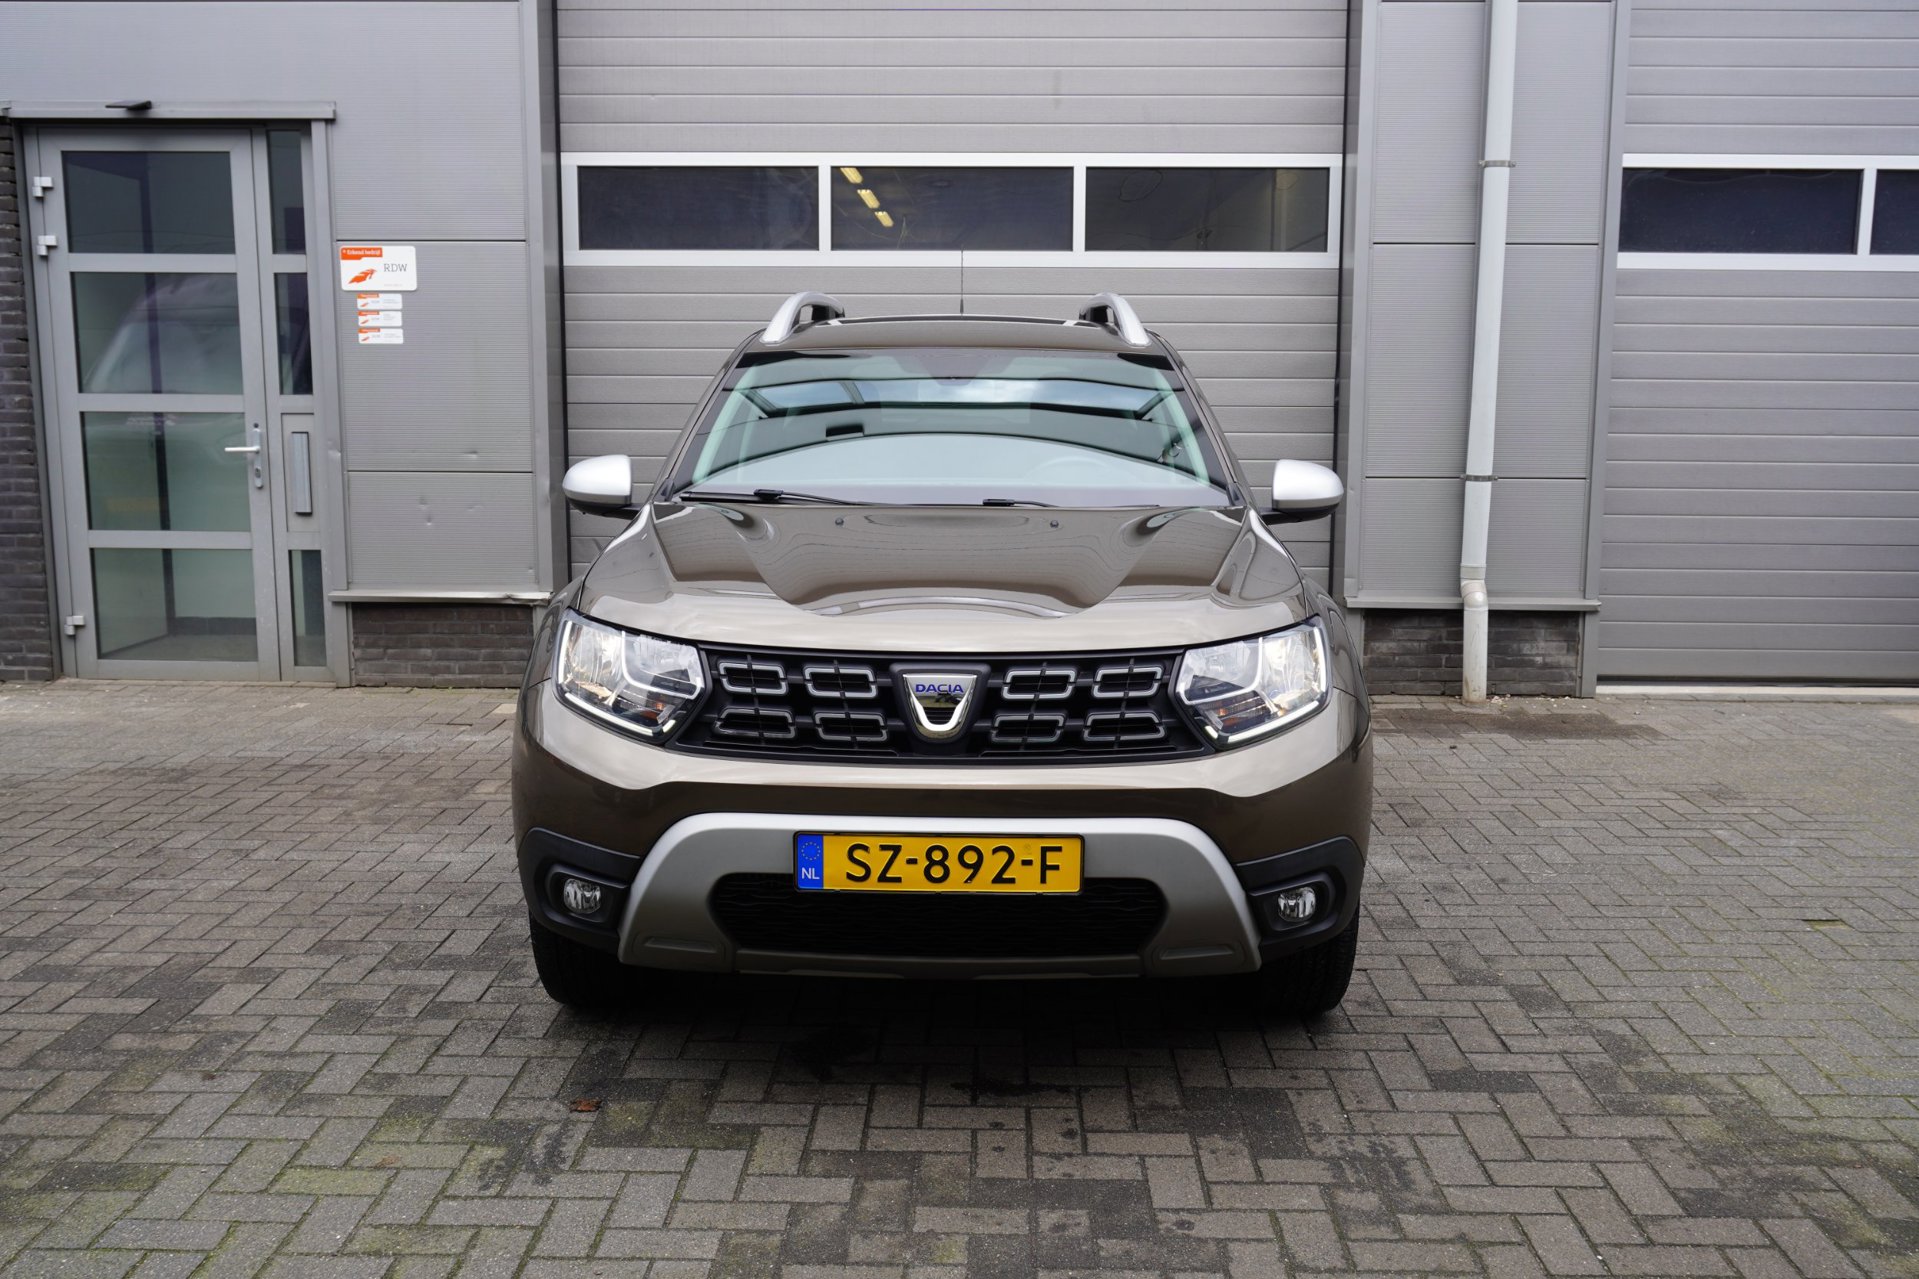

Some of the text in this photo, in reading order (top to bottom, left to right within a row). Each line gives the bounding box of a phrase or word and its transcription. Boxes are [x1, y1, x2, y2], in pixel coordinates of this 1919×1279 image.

[384, 263, 408, 272] RDW
[915, 684, 964, 693] DACIA
[845, 843, 1063, 884] SZ-892-F
[801, 867, 820, 879] NL
